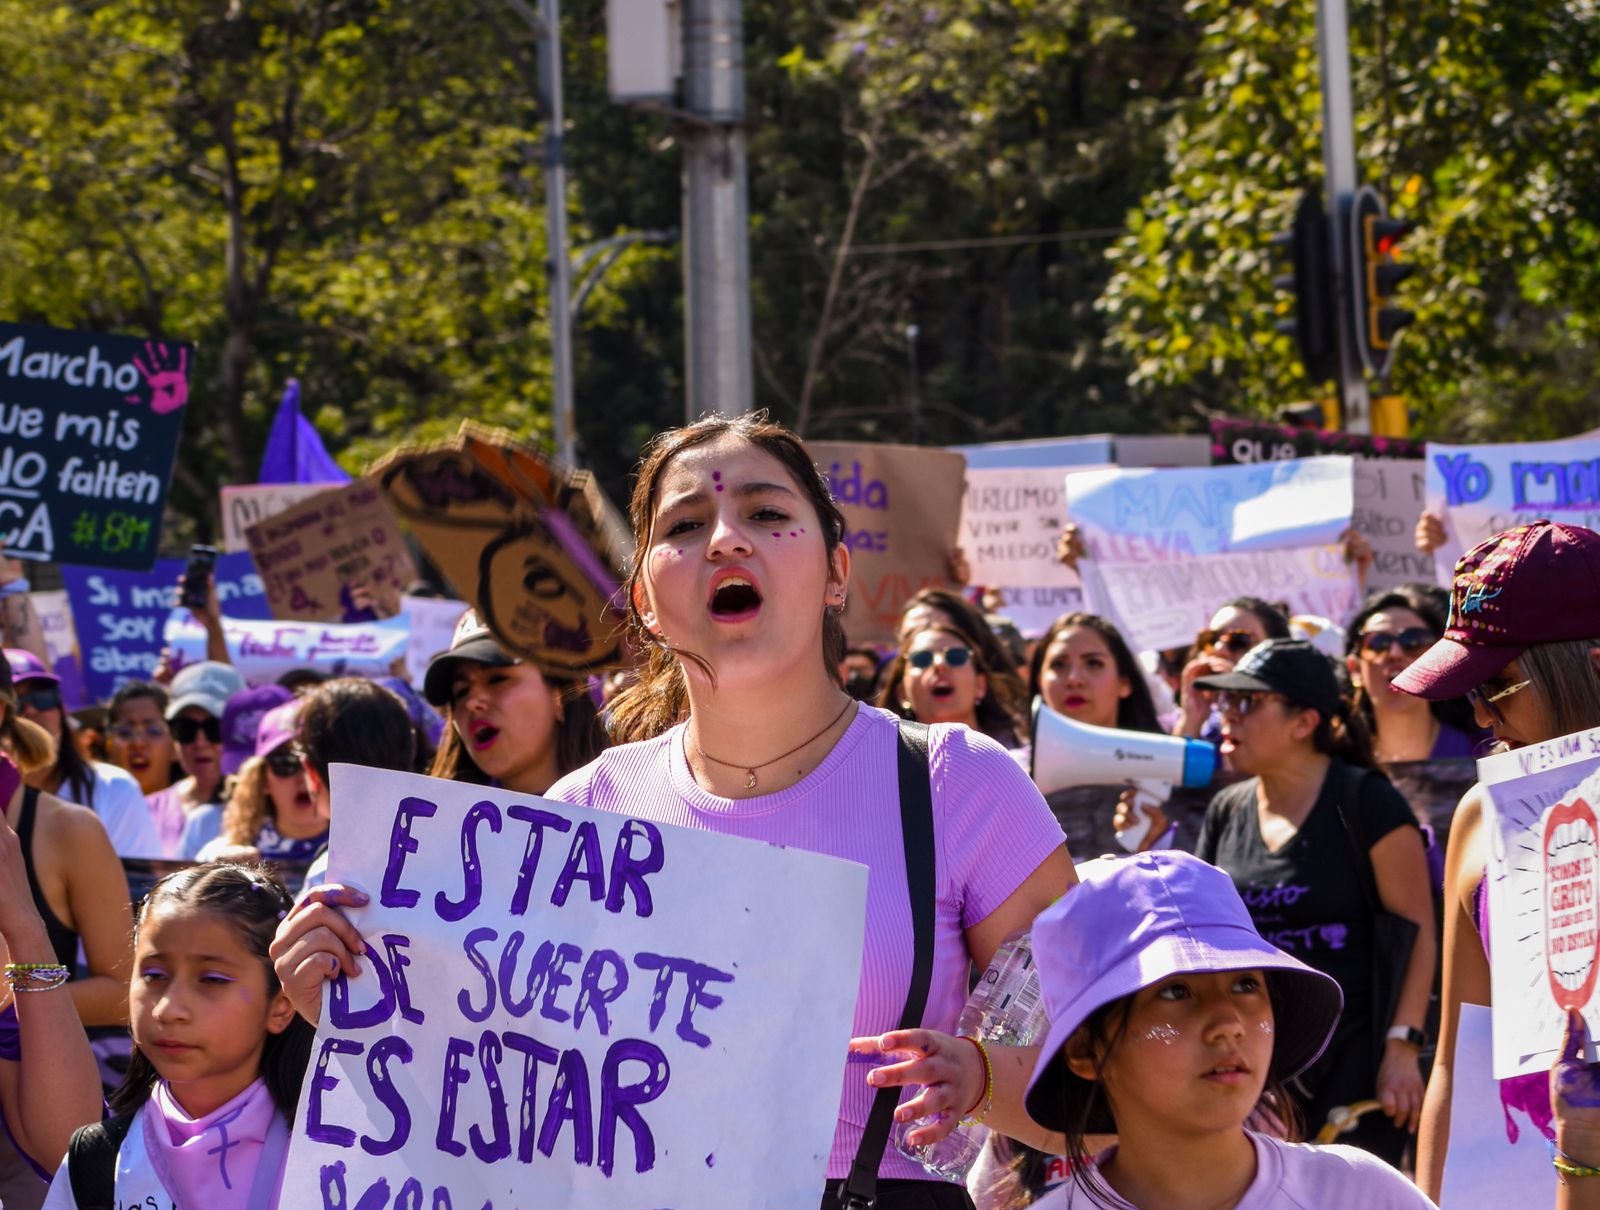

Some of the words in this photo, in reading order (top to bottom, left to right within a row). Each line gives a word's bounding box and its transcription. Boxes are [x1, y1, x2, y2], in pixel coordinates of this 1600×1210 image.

[0, 403, 44, 439] ue
[55, 410, 140, 450] mis
[58, 456, 161, 505] falten
[831, 463, 889, 512] ida
[1434, 454, 1492, 507] Yo
[0, 501, 54, 552] CA
[380, 797, 665, 921] ESTAR
[329, 934, 424, 1029] DE
[458, 928, 735, 1048] SUERTE
[306, 1036, 414, 1156] ES
[436, 1031, 671, 1178] ESTAR
